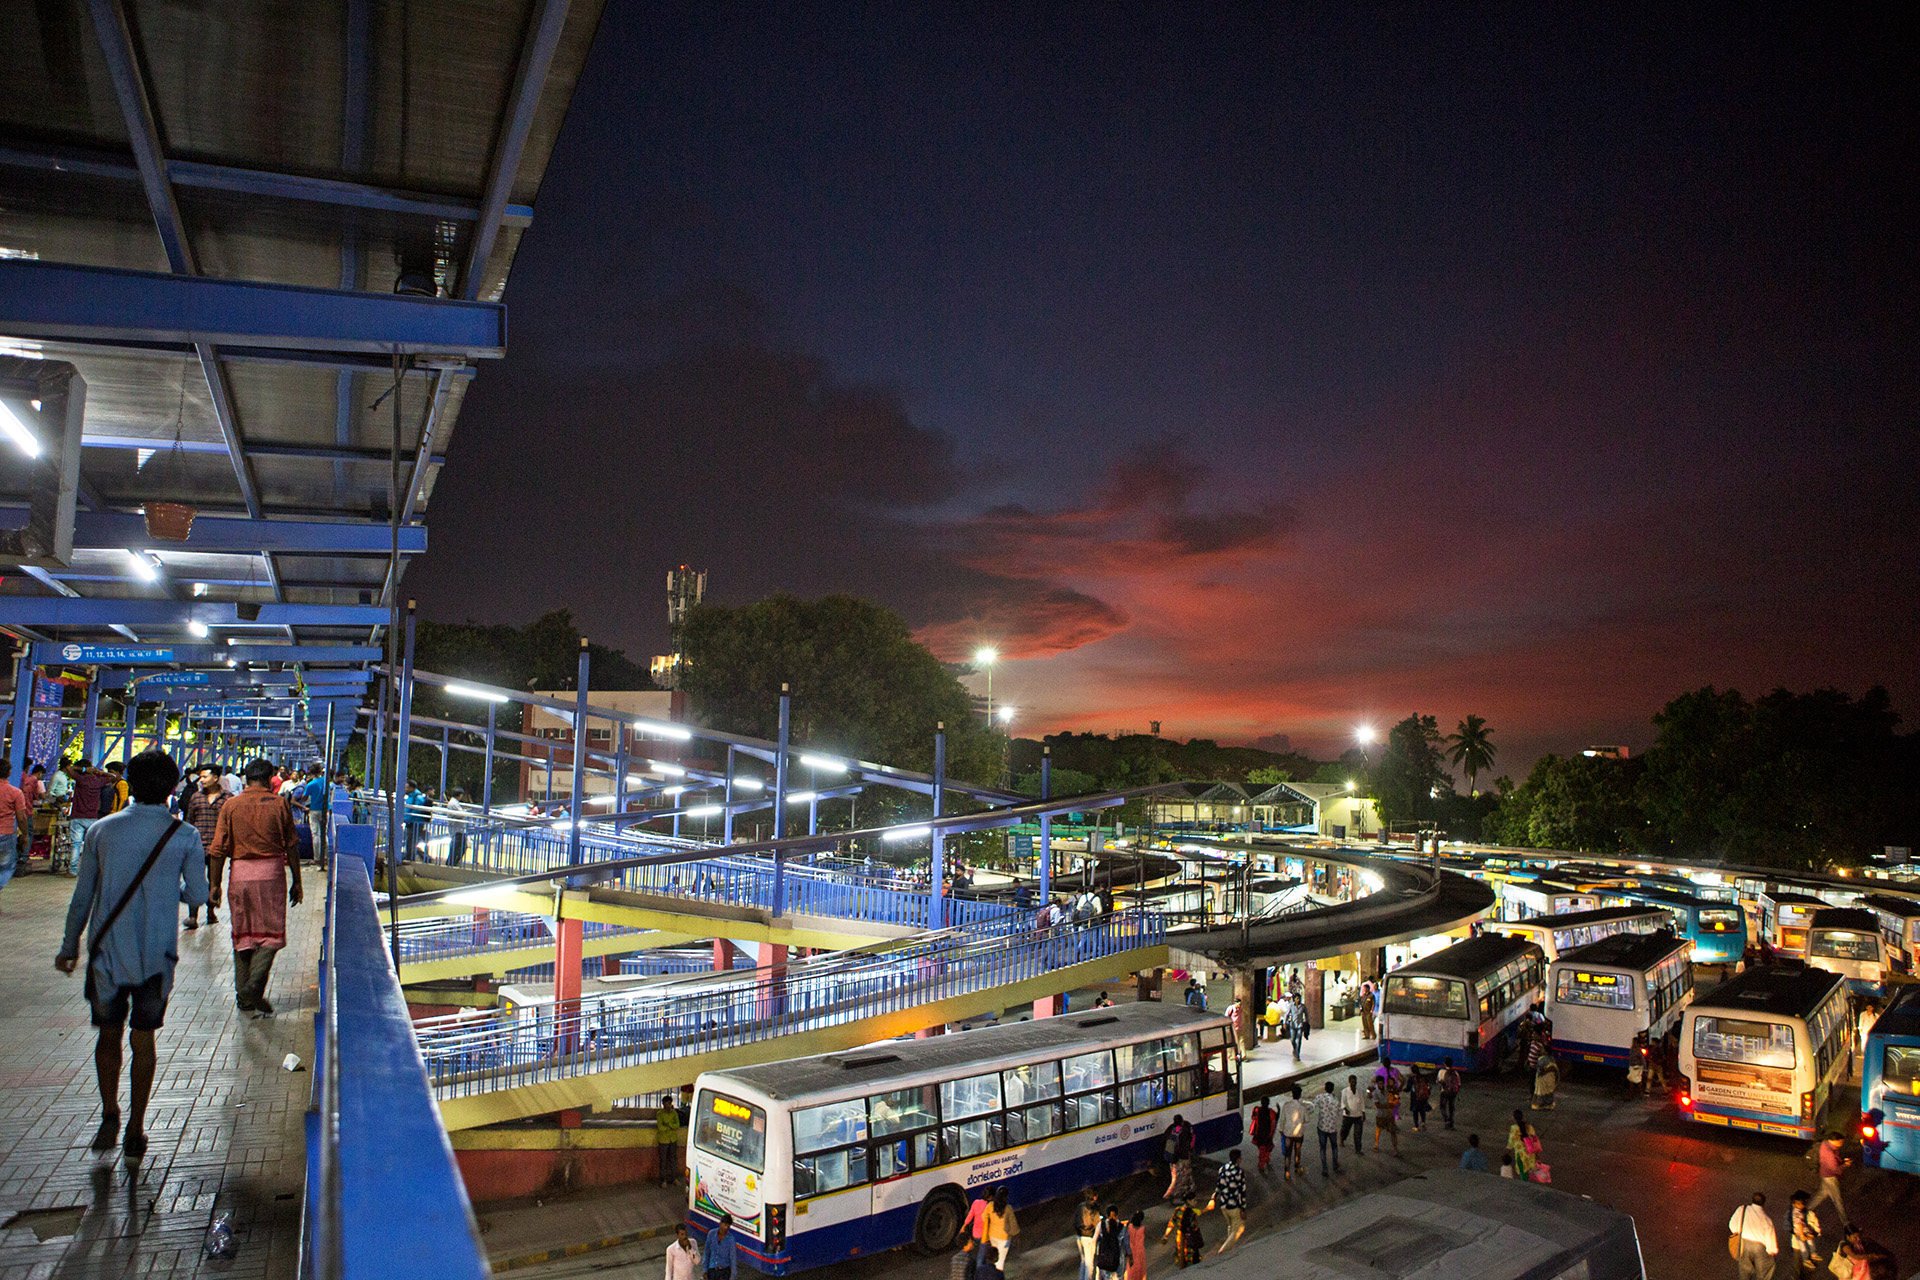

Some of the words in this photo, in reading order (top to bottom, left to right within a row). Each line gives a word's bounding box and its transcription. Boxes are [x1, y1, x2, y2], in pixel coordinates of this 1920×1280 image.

[1706, 1085, 1732, 1095] GARDEN
[1732, 1088, 1746, 1096] CITY
[1747, 1092, 1790, 1102] UNIVERSITY
[716, 1122, 743, 1140] BMTC
[1133, 1123, 1156, 1134] BMTC
[972, 1159, 1001, 1171] BENGALURU
[1001, 1153, 1019, 1164] SARIGE
